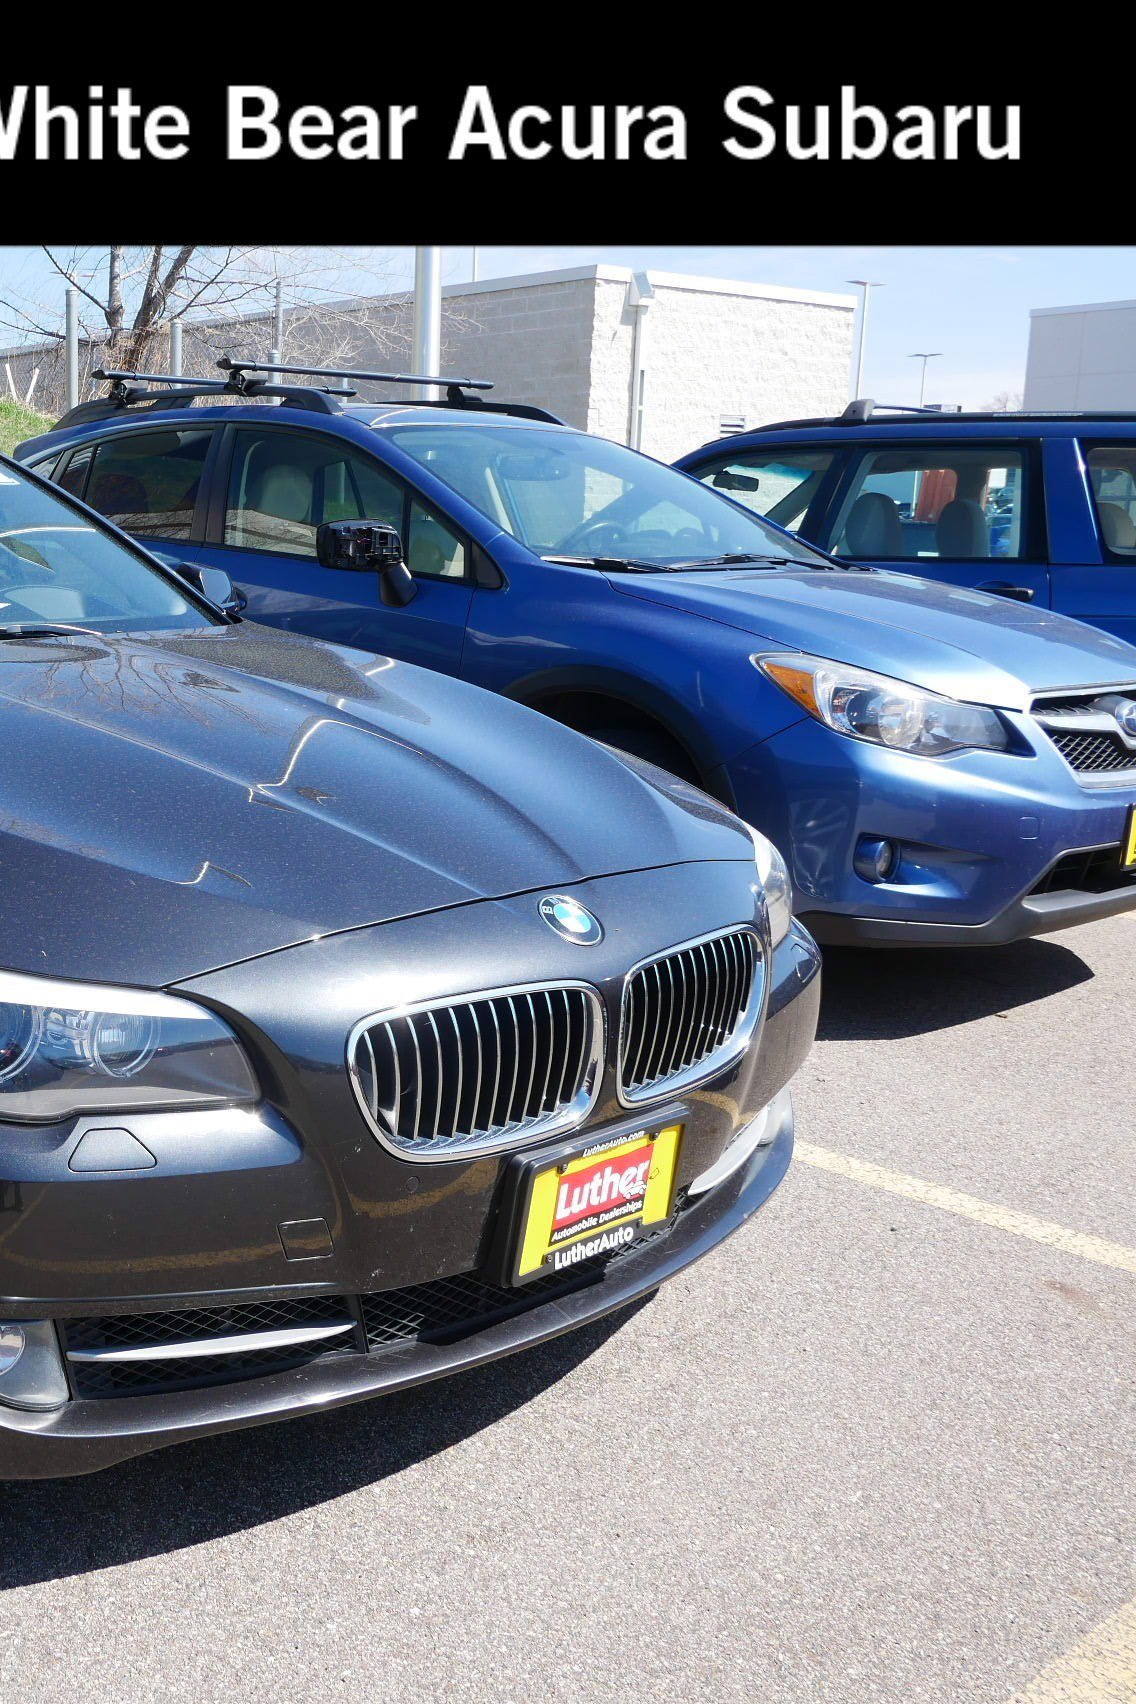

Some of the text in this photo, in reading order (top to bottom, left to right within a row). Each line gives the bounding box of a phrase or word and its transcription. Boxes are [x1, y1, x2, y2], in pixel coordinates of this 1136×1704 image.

[583, 1131, 645, 1157] LutherAuto.com
[556, 1160, 651, 1220] Luther
[551, 1200, 642, 1242] Automobile Dealerships
[555, 1226, 634, 1269] LutherAuto
